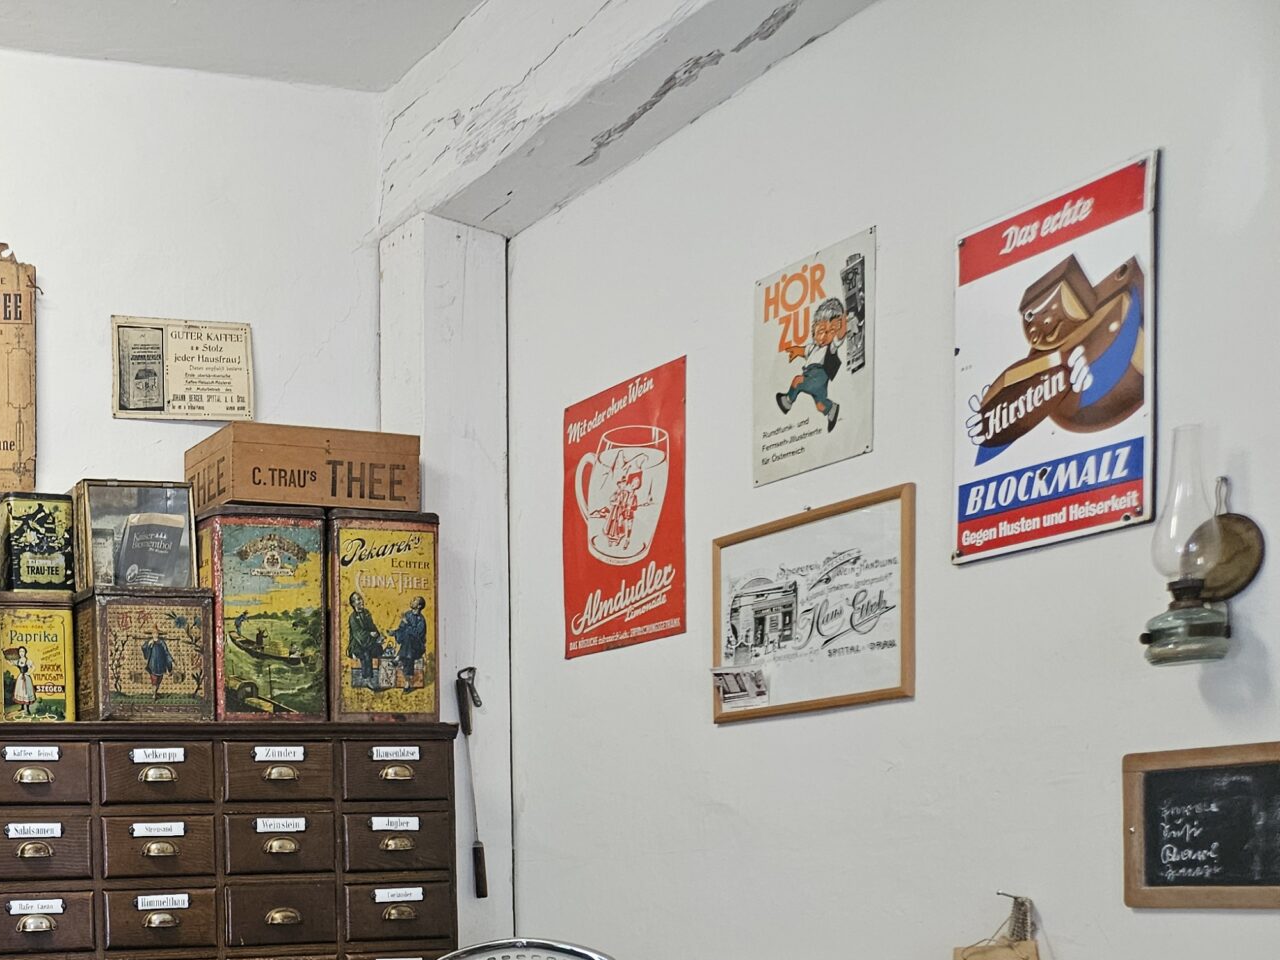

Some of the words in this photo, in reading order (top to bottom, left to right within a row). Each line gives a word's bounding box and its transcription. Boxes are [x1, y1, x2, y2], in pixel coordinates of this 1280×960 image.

[999, 219, 1037, 256] Das
[1040, 197, 1095, 239] echte
[763, 263, 826, 323] HÖR
[170, 330, 203, 341] GUTER
[206, 331, 243, 343] KAFFEE
[778, 306, 811, 353] ZU
[202, 344, 223, 353] Stolz
[174, 353, 195, 363] jeder
[197, 354, 241, 365] Hausfrau!
[567, 422, 588, 444] Mit
[586, 410, 606, 431] oder
[607, 396, 628, 419] ohne
[628, 377, 654, 405] Wein
[797, 417, 810, 428] und
[771, 446, 806, 463] Österreich
[325, 459, 407, 502] THEE
[964, 445, 1131, 518] BLOCKMALZ
[962, 520, 997, 548] Gegen
[998, 513, 1041, 538] Husten
[1043, 507, 1067, 530] und
[1069, 488, 1139, 521] Heiserkeit
[340, 533, 421, 567] Pekarek's
[26, 565, 60, 576] TRAU-TEE
[391, 558, 430, 570] ECHTER
[571, 560, 676, 636] Almdudler
[624, 593, 667, 622] Limonade
[9, 630, 58, 644] Paprika
[265, 747, 297, 758] Zünder
[14, 824, 55, 835] Salatsamen
[263, 820, 300, 830] Weinstein
